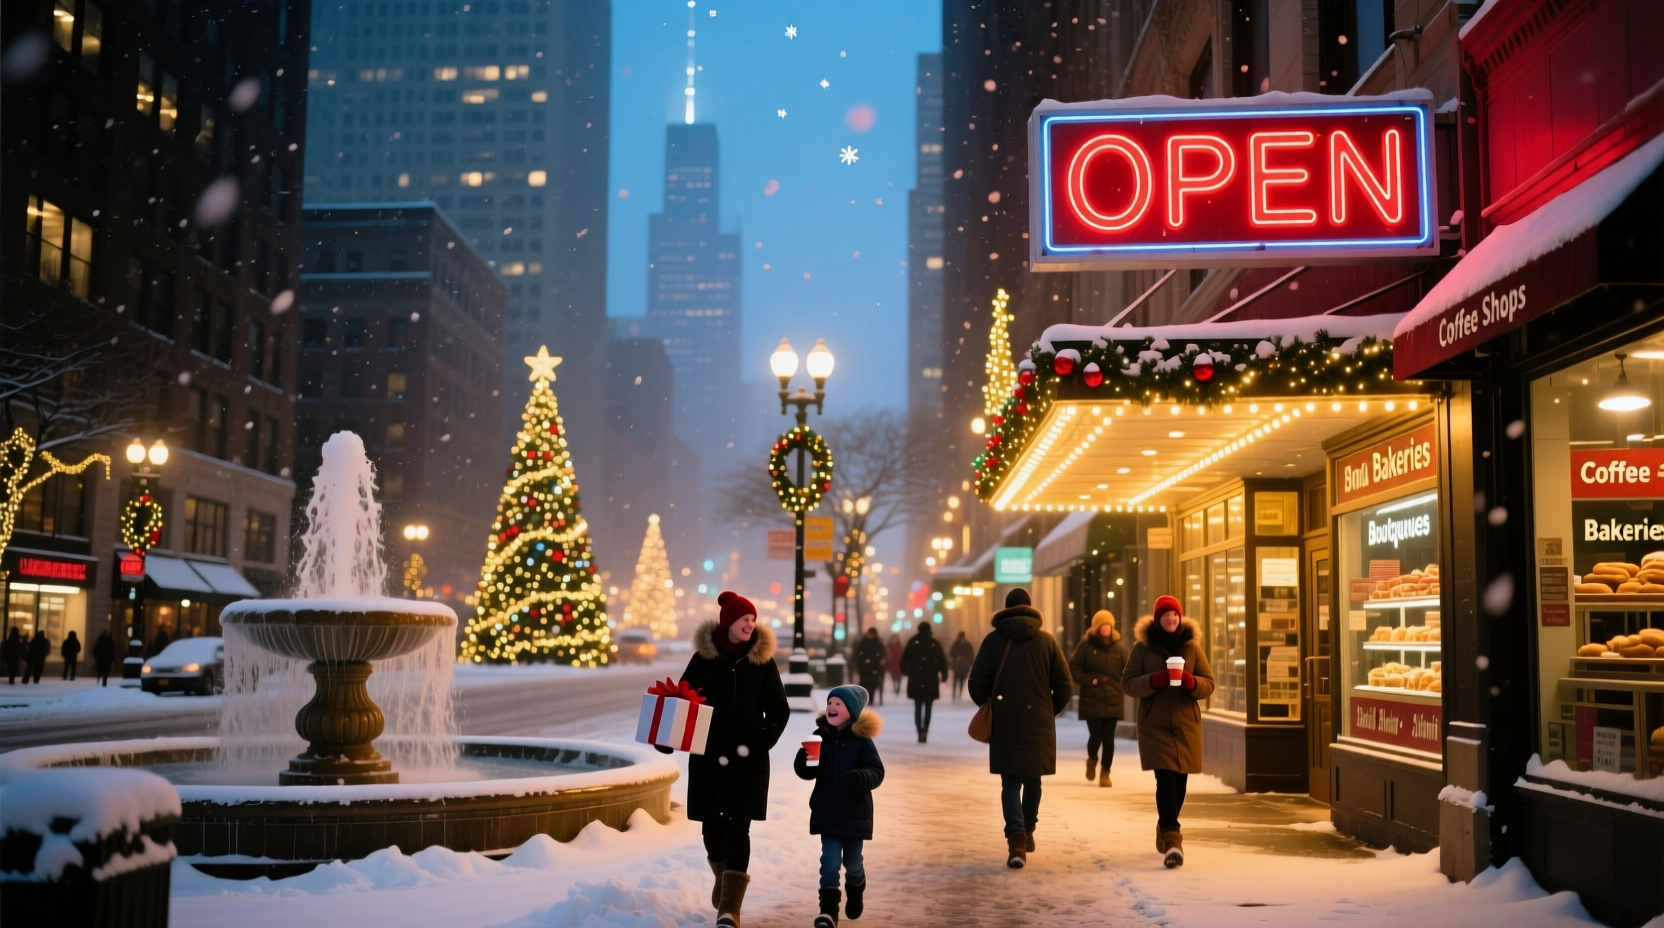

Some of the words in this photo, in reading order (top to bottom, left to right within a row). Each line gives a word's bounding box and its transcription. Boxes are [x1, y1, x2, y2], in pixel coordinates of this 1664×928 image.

[1067, 129, 1402, 231] OPEN
[1438, 307, 1479, 348] Coffee
[1482, 284, 1526, 327] Shops
[1372, 437, 1431, 483] Bakeries
[1580, 460, 1651, 484] Coffee
